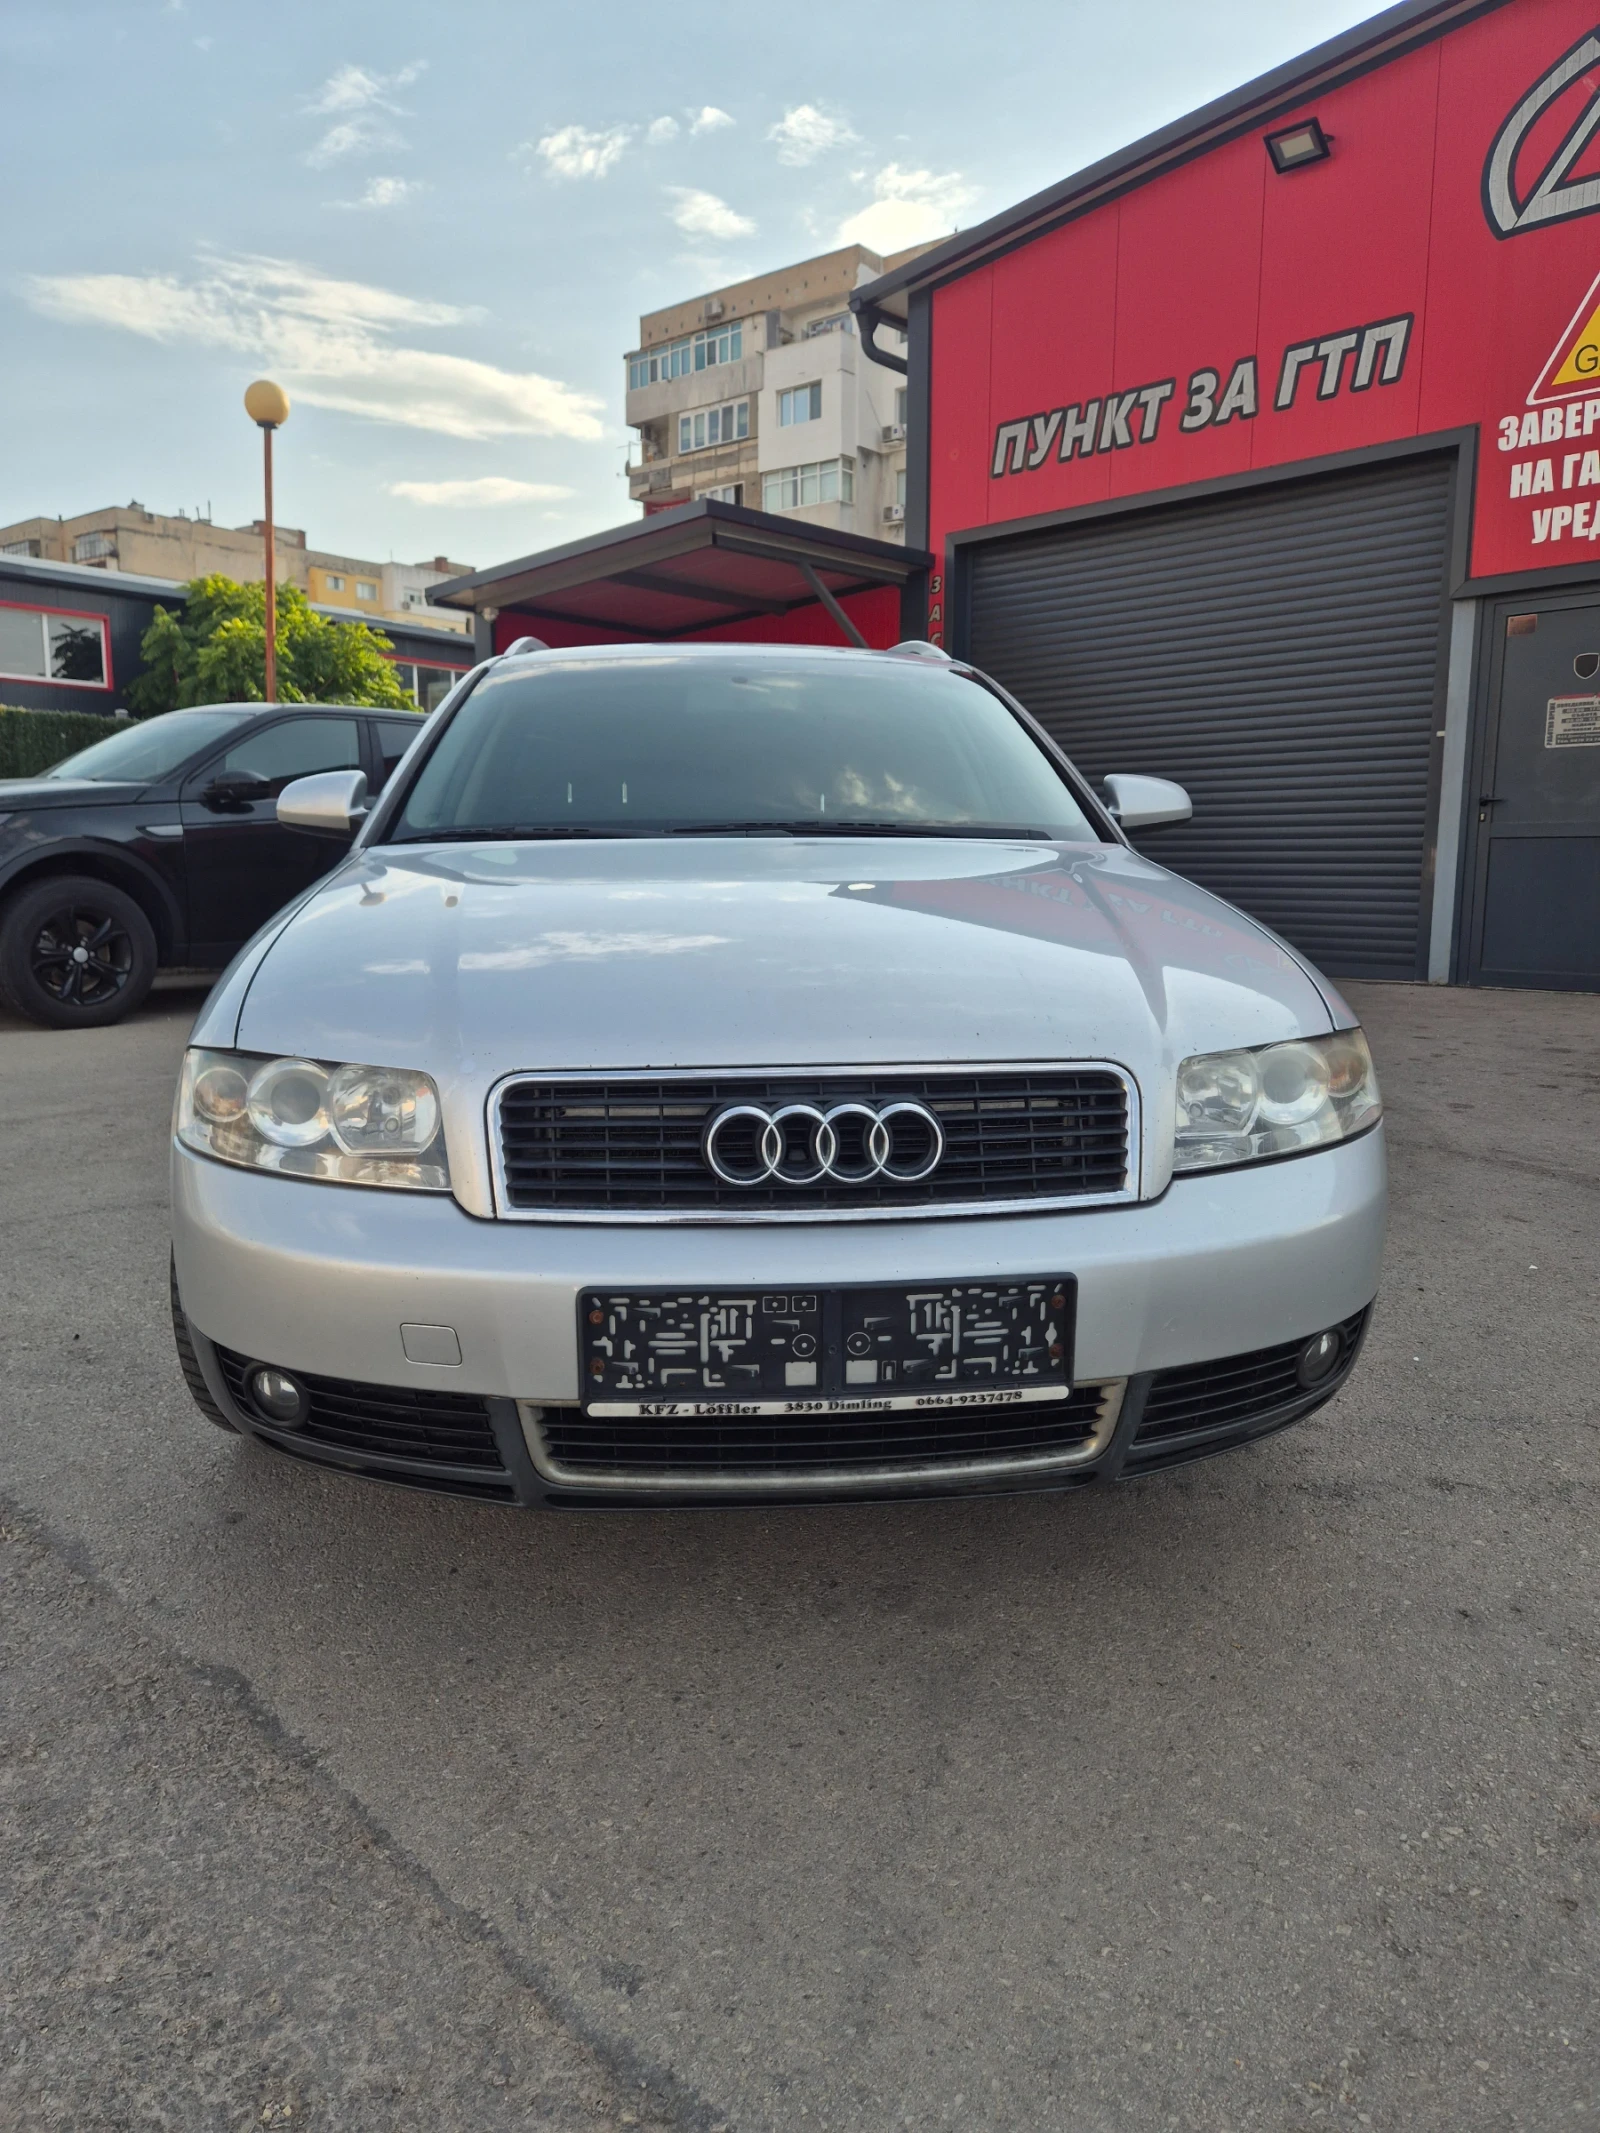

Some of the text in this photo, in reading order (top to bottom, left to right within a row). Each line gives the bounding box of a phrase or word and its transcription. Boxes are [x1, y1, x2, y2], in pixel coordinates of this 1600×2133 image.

[1574, 344, 1600, 374] G
[992, 314, 1413, 477] ПУНКТ ЗА ГТП
[1509, 458, 1554, 499] НА
[639, 1404, 679, 1415] KFZ
[694, 1402, 761, 1415] Löffler
[784, 1401, 823, 1412] 3830
